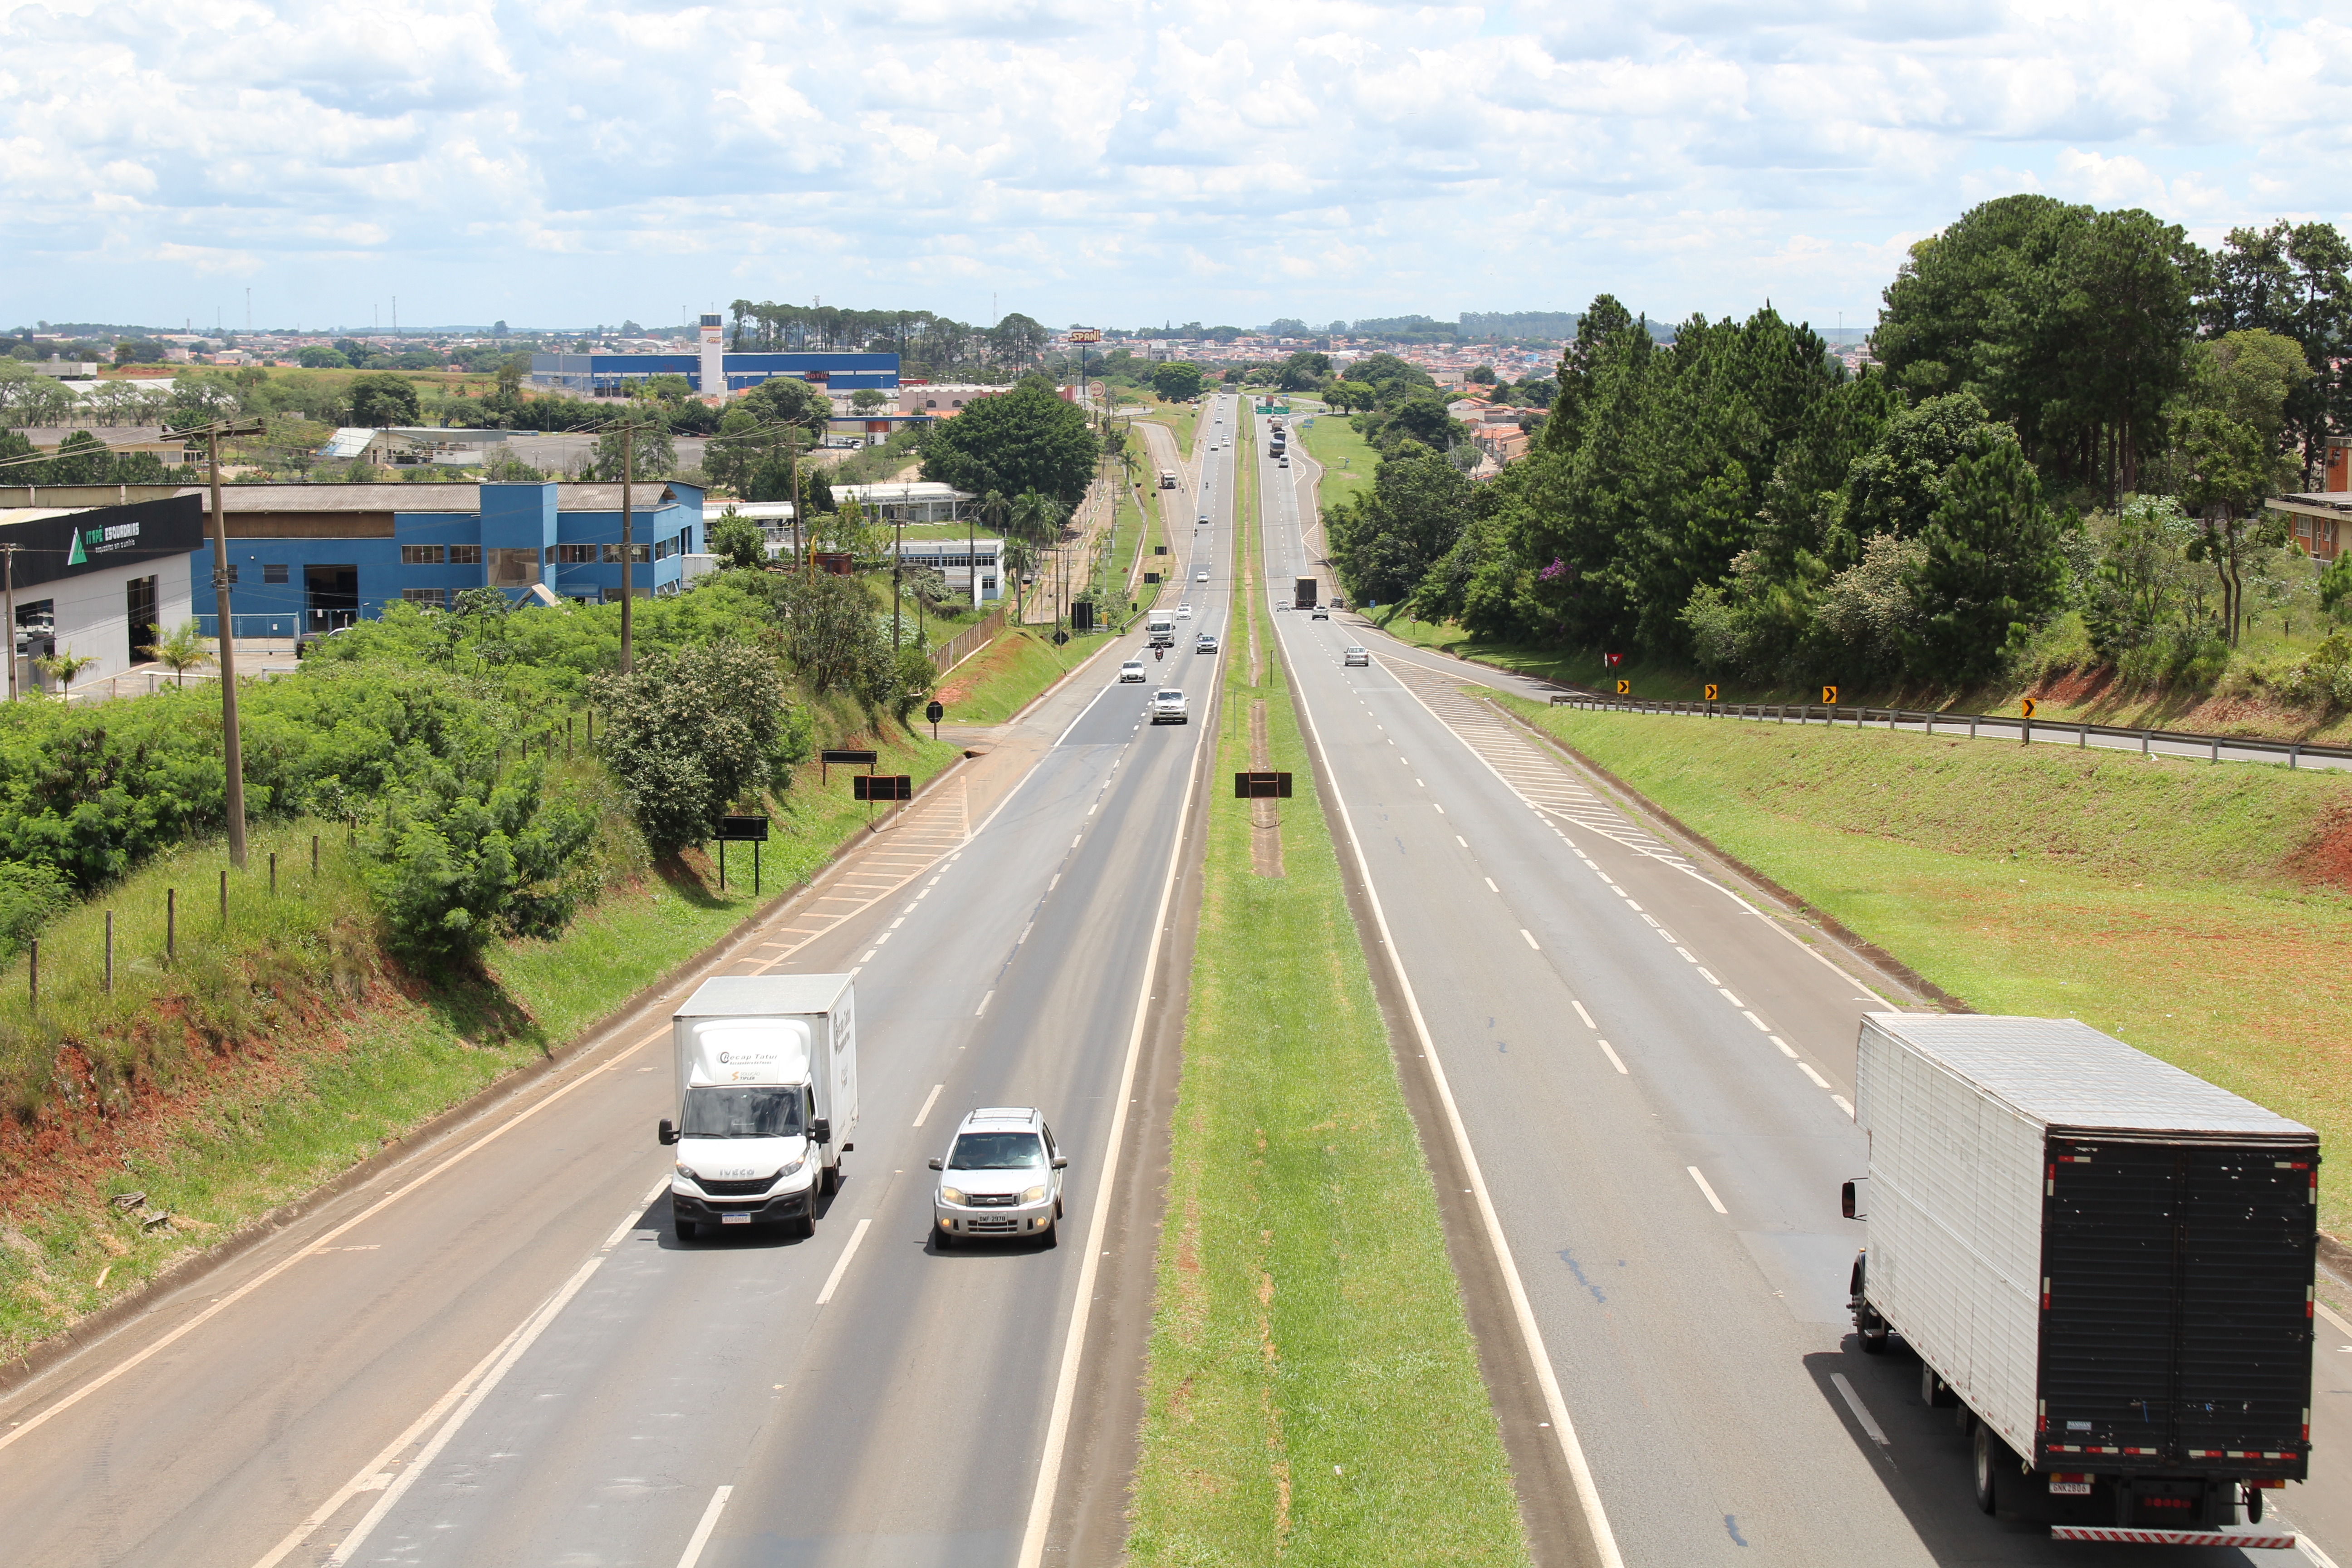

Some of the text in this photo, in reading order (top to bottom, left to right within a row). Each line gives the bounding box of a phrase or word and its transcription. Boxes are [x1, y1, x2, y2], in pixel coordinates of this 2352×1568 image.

[1070, 331, 1099, 341] SPANI
[86, 522, 140, 544] ITAPÊ ESQUADRIAS
[719, 1168, 755, 1176] IVECO
